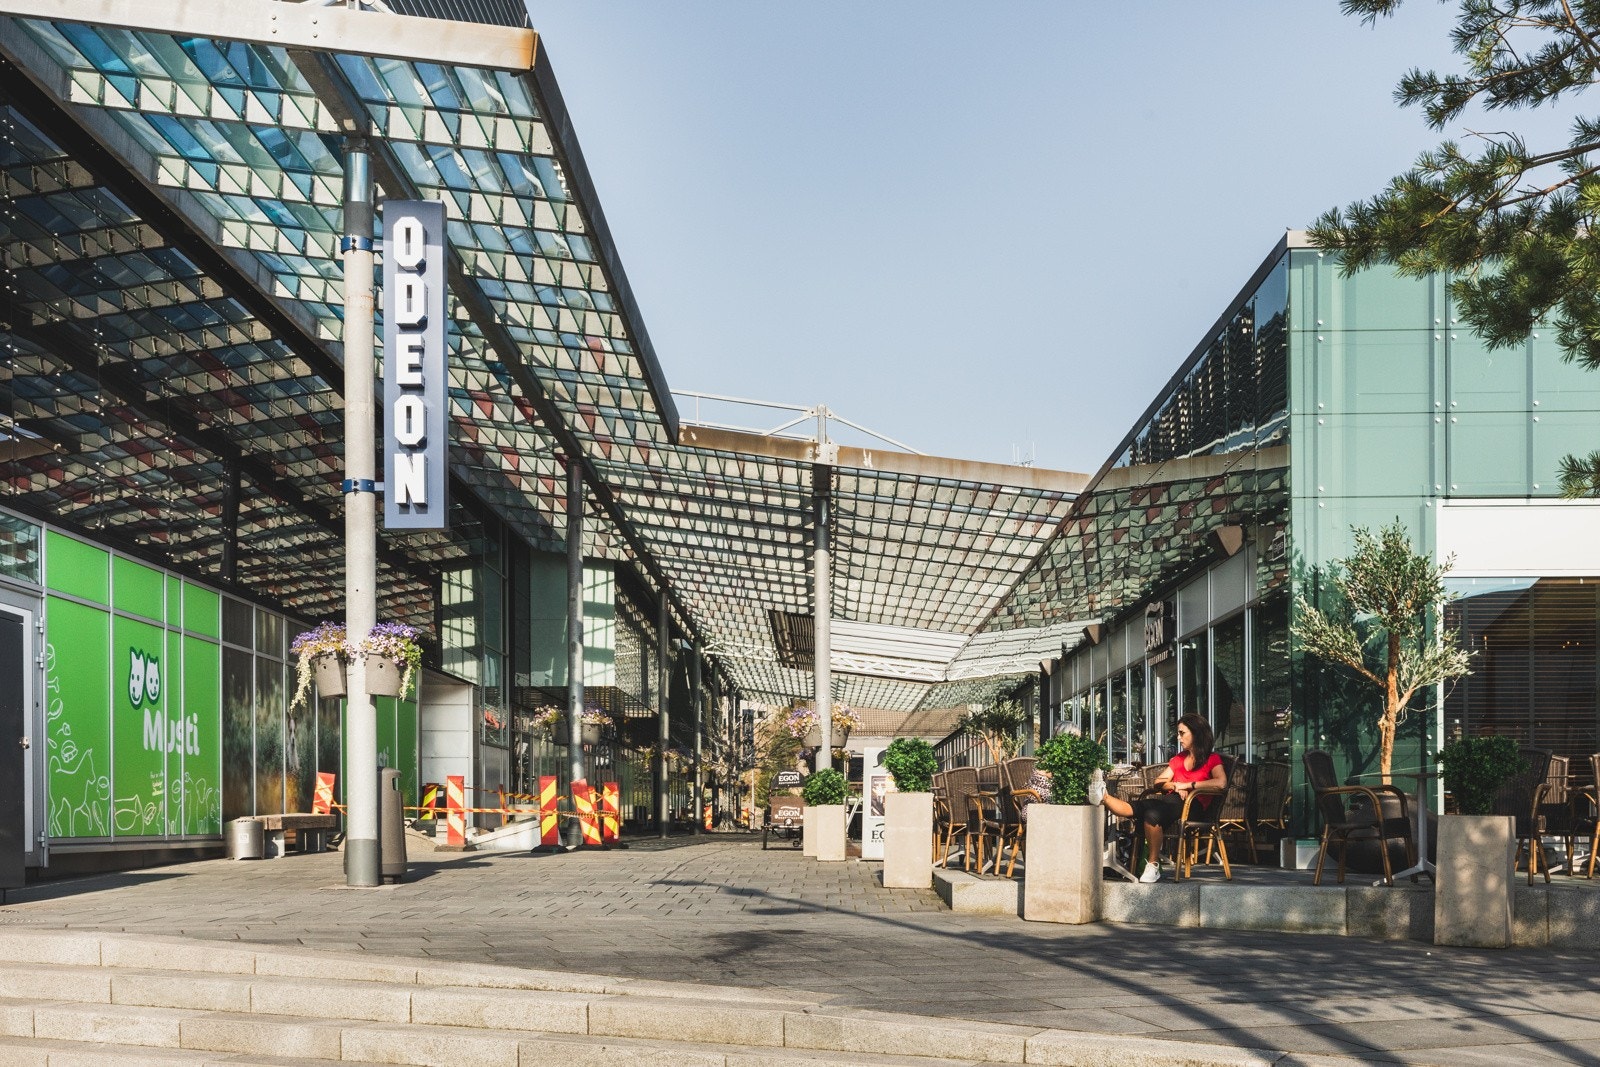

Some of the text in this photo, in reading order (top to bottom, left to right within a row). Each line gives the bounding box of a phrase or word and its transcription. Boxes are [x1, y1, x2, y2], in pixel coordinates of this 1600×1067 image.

[393, 216, 427, 505] ODEON
[143, 708, 200, 756] Musti
[778, 774, 800, 782] EGON
[778, 809, 800, 817] EGON
